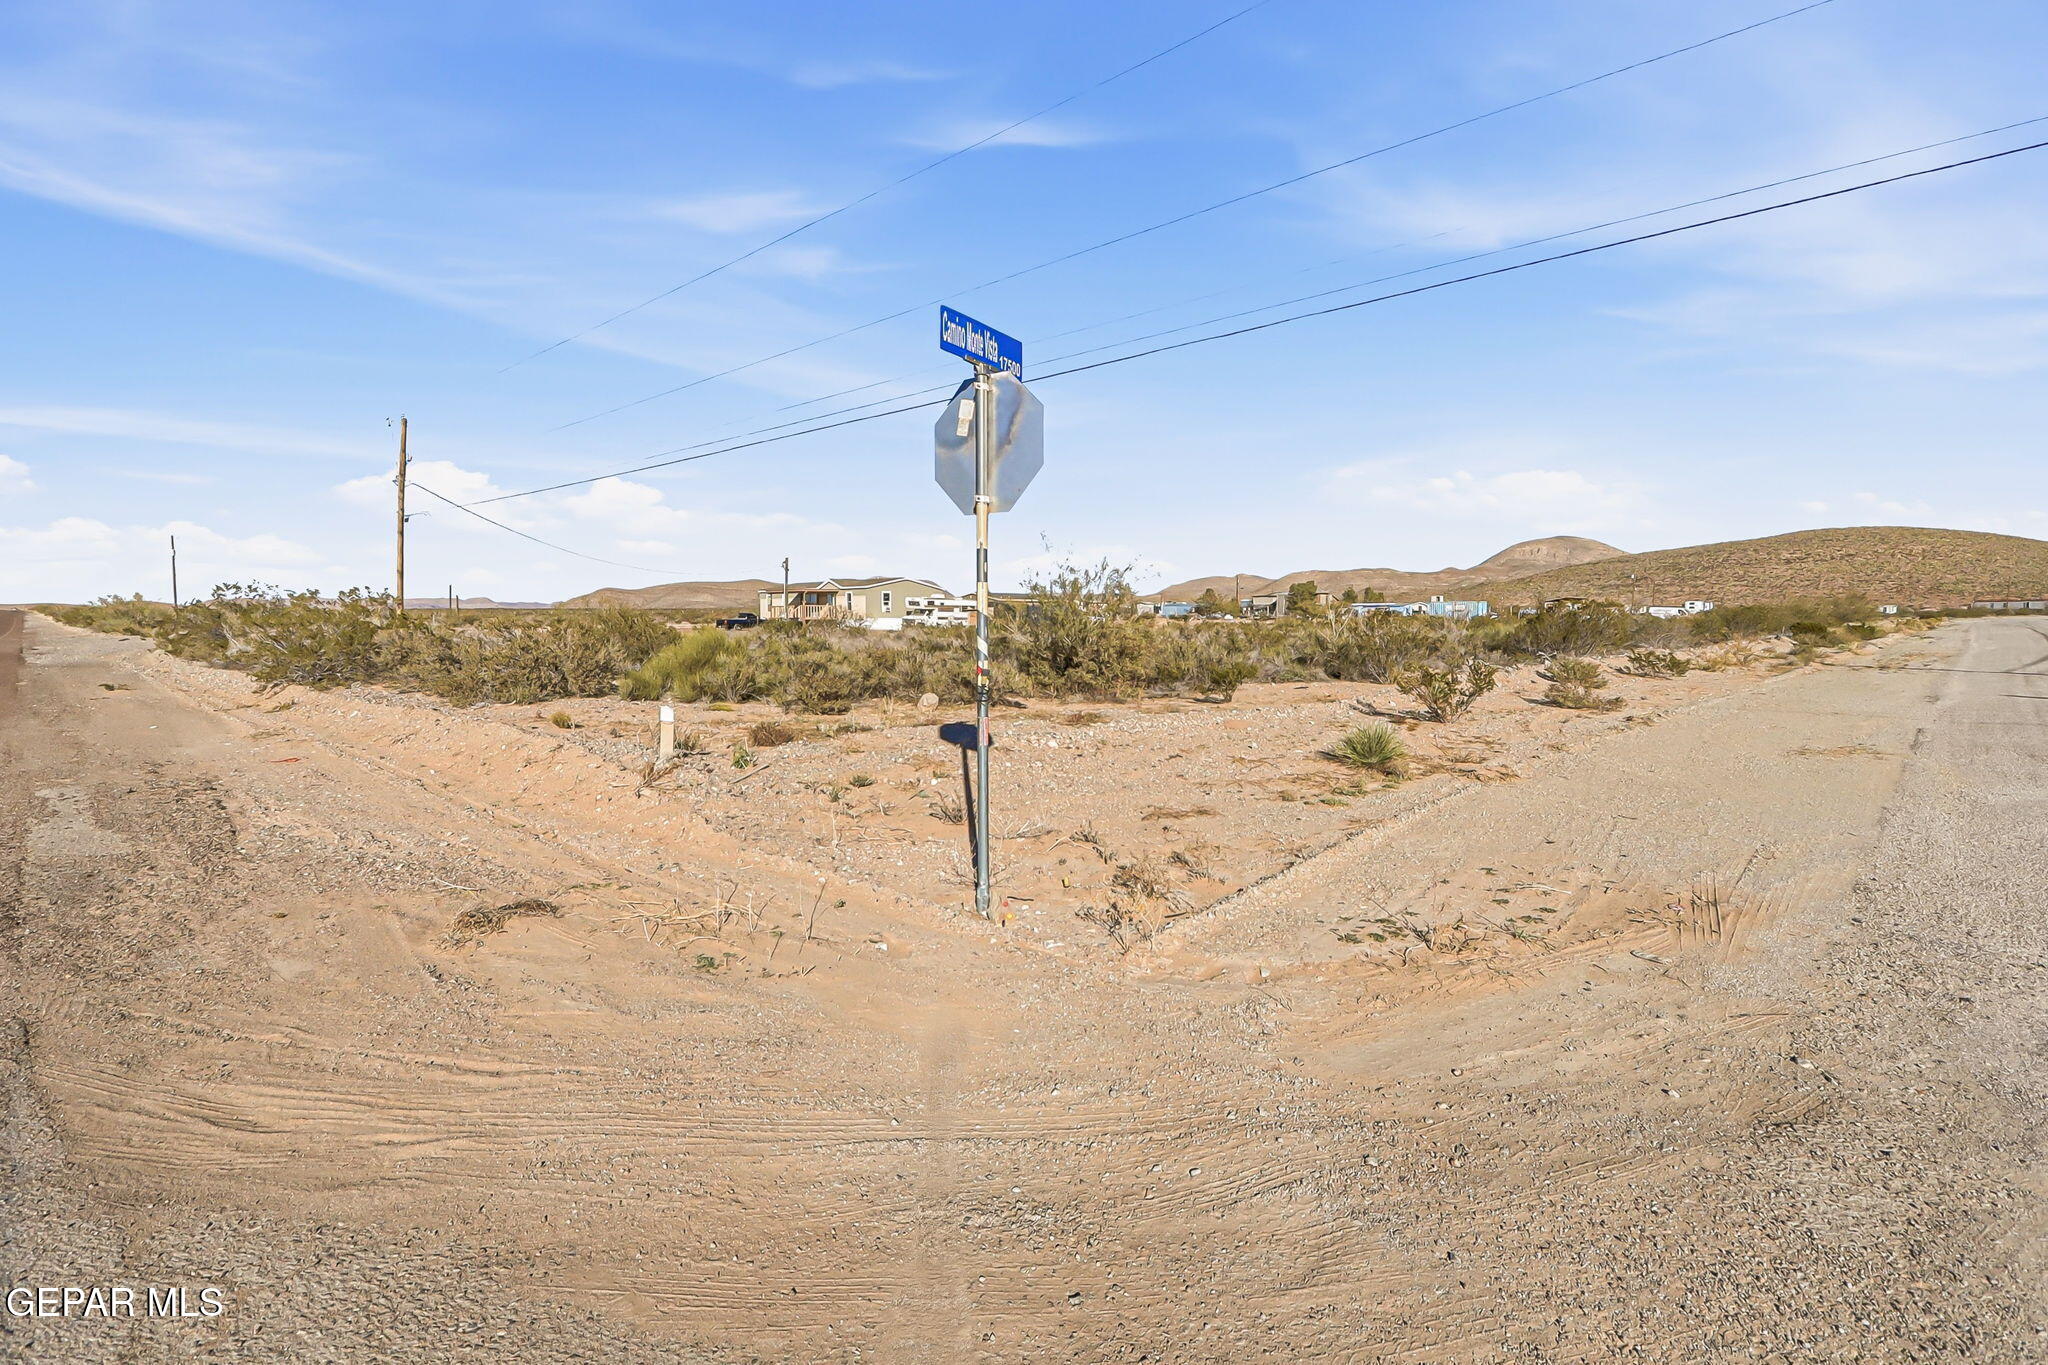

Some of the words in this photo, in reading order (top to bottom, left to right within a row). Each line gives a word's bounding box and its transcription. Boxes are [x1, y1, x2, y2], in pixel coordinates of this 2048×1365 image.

[942, 310, 966, 350] Camino
[966, 321, 984, 357] Monte
[984, 329, 998, 363] Vista
[999, 355, 1021, 378] 17500
